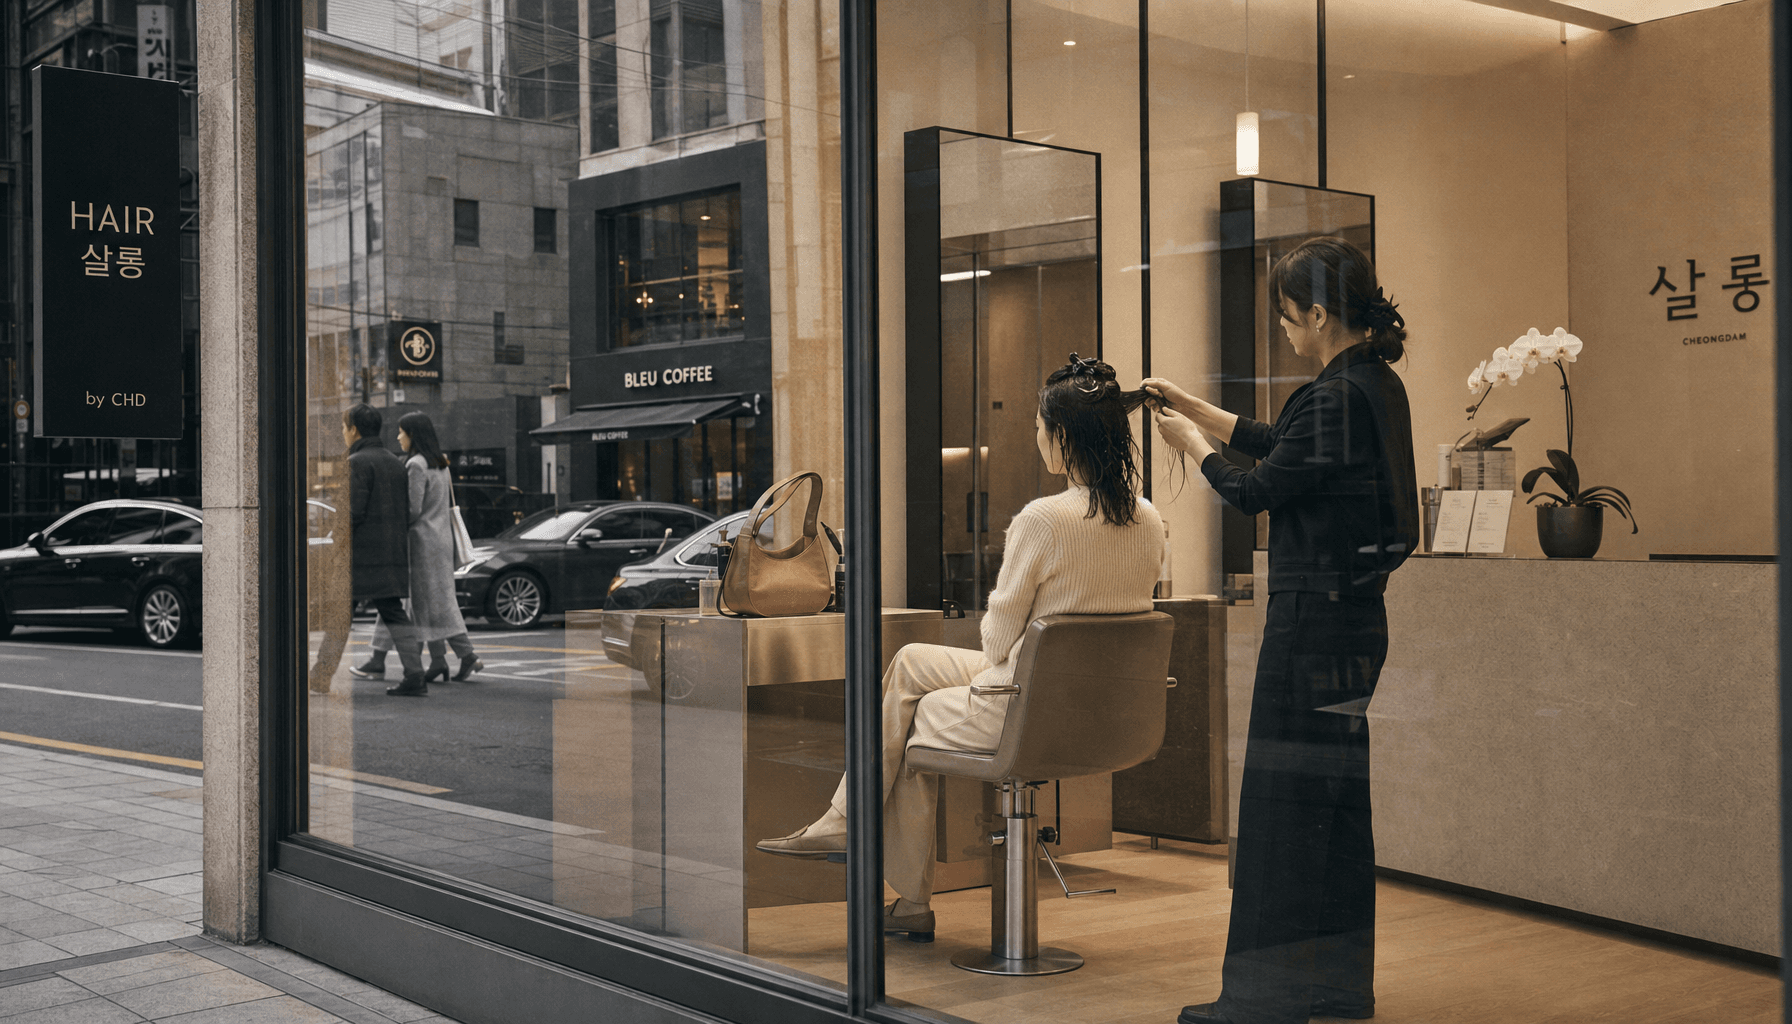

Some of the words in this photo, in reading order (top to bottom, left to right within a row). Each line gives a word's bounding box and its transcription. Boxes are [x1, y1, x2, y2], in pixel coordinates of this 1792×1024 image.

[70, 200, 155, 236] HAIR
[81, 243, 146, 280] 살롱
[1648, 253, 1770, 322] 살롱
[1682, 332, 1747, 346] CHEONGDAM
[624, 370, 658, 389] BLEU
[662, 365, 713, 385] COFFEE
[85, 390, 105, 409] by
[111, 392, 147, 407] CHD
